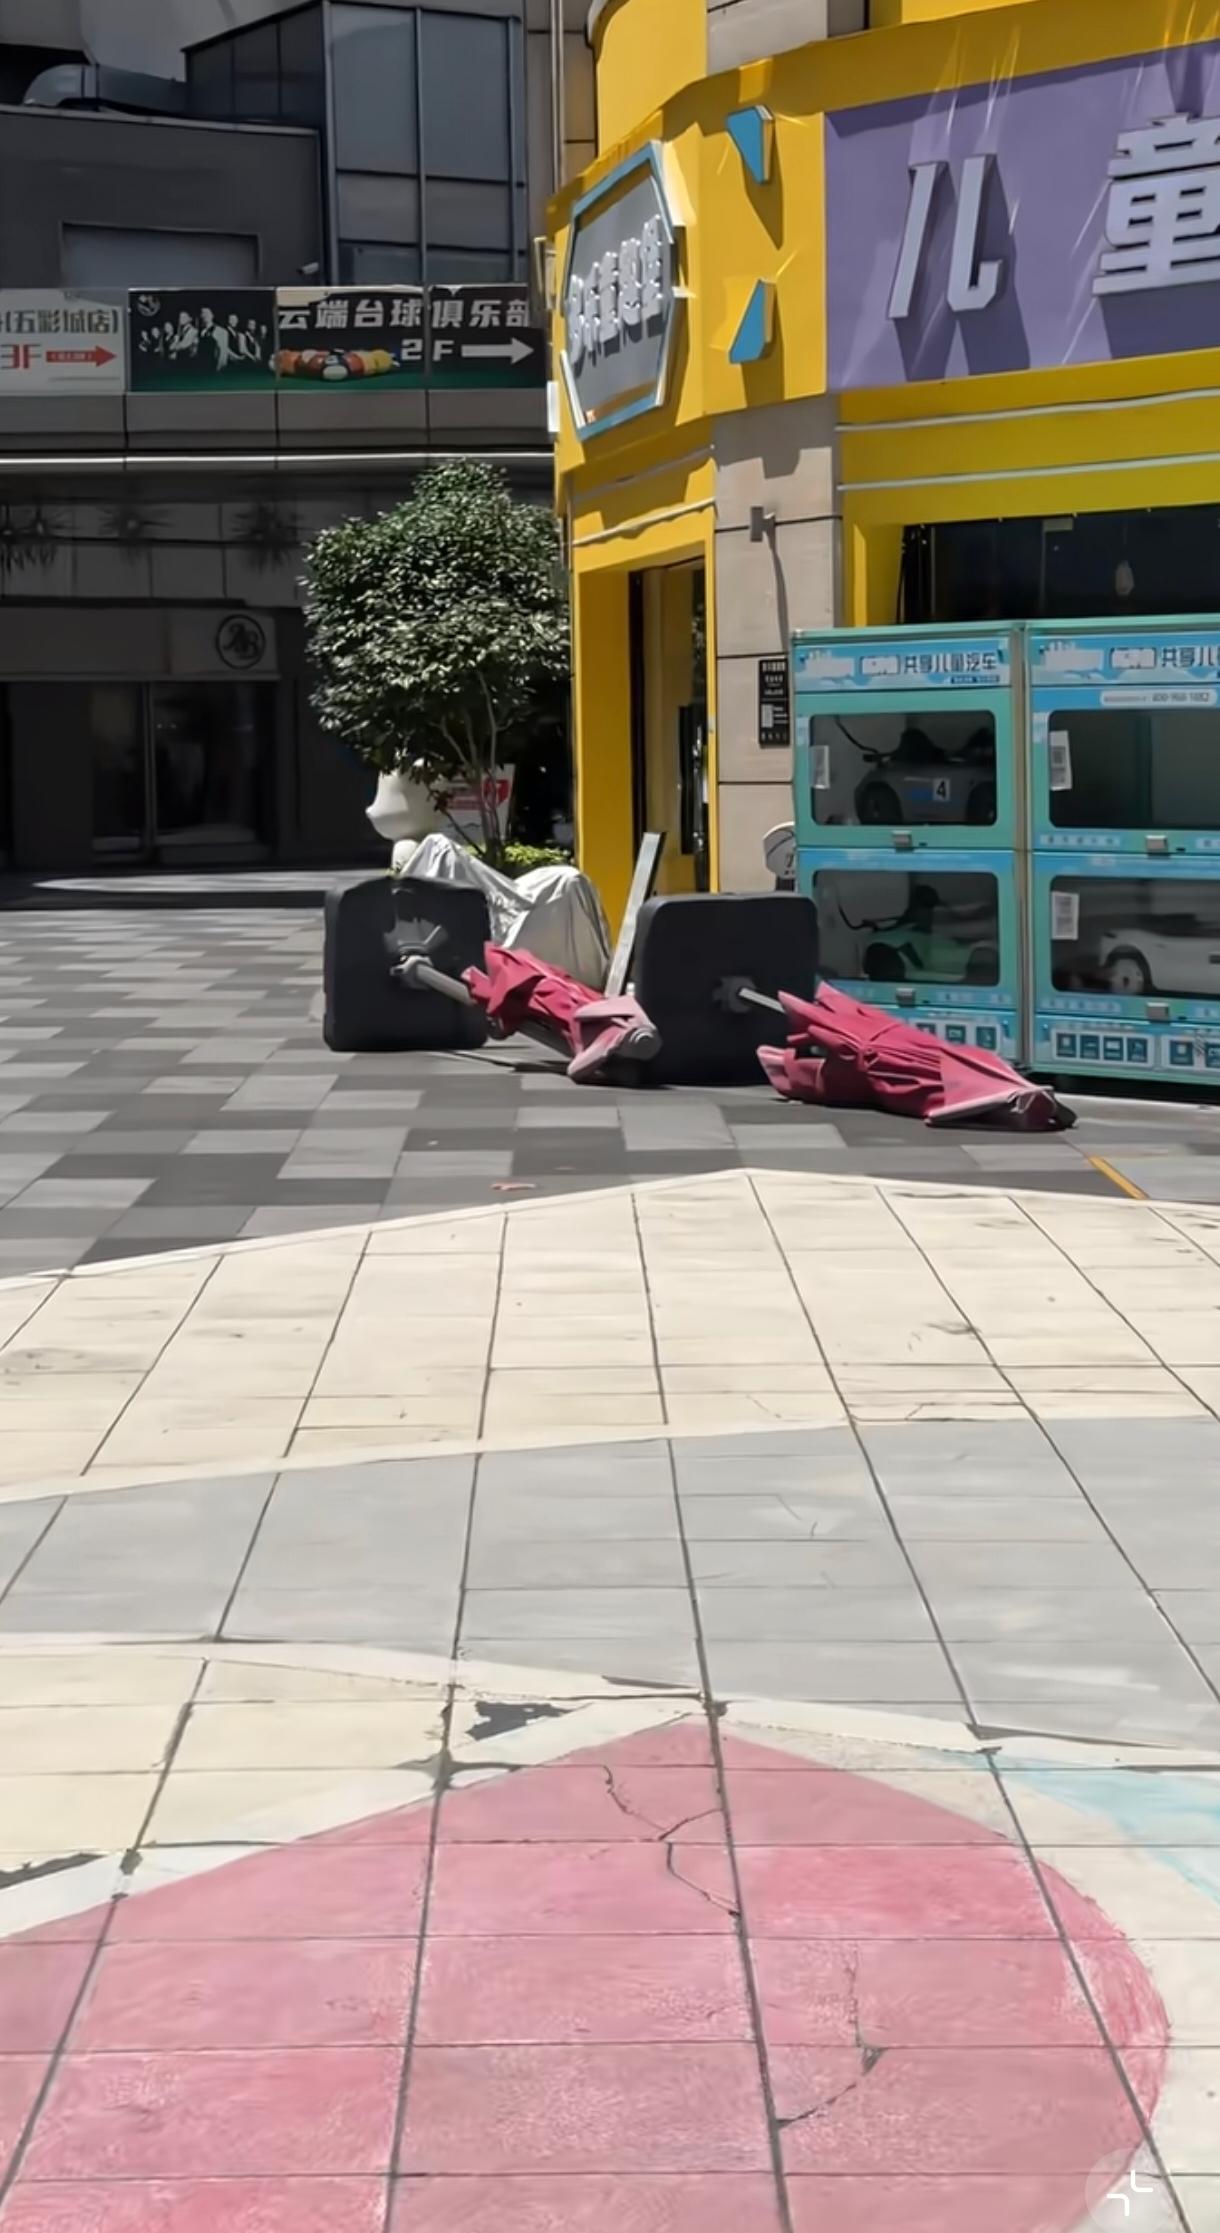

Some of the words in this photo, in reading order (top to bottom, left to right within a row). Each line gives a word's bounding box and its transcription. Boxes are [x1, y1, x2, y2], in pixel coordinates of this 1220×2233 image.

[0, 308, 119, 334] (五彩城店)
[278, 299, 529, 329] 云端台球俱乐部
[401, 338, 454, 361] 2F
[904, 653, 997, 674] 共享儿童汽车
[1162, 646, 1220, 667] 共享儿
[936, 780, 946, 799] 4
